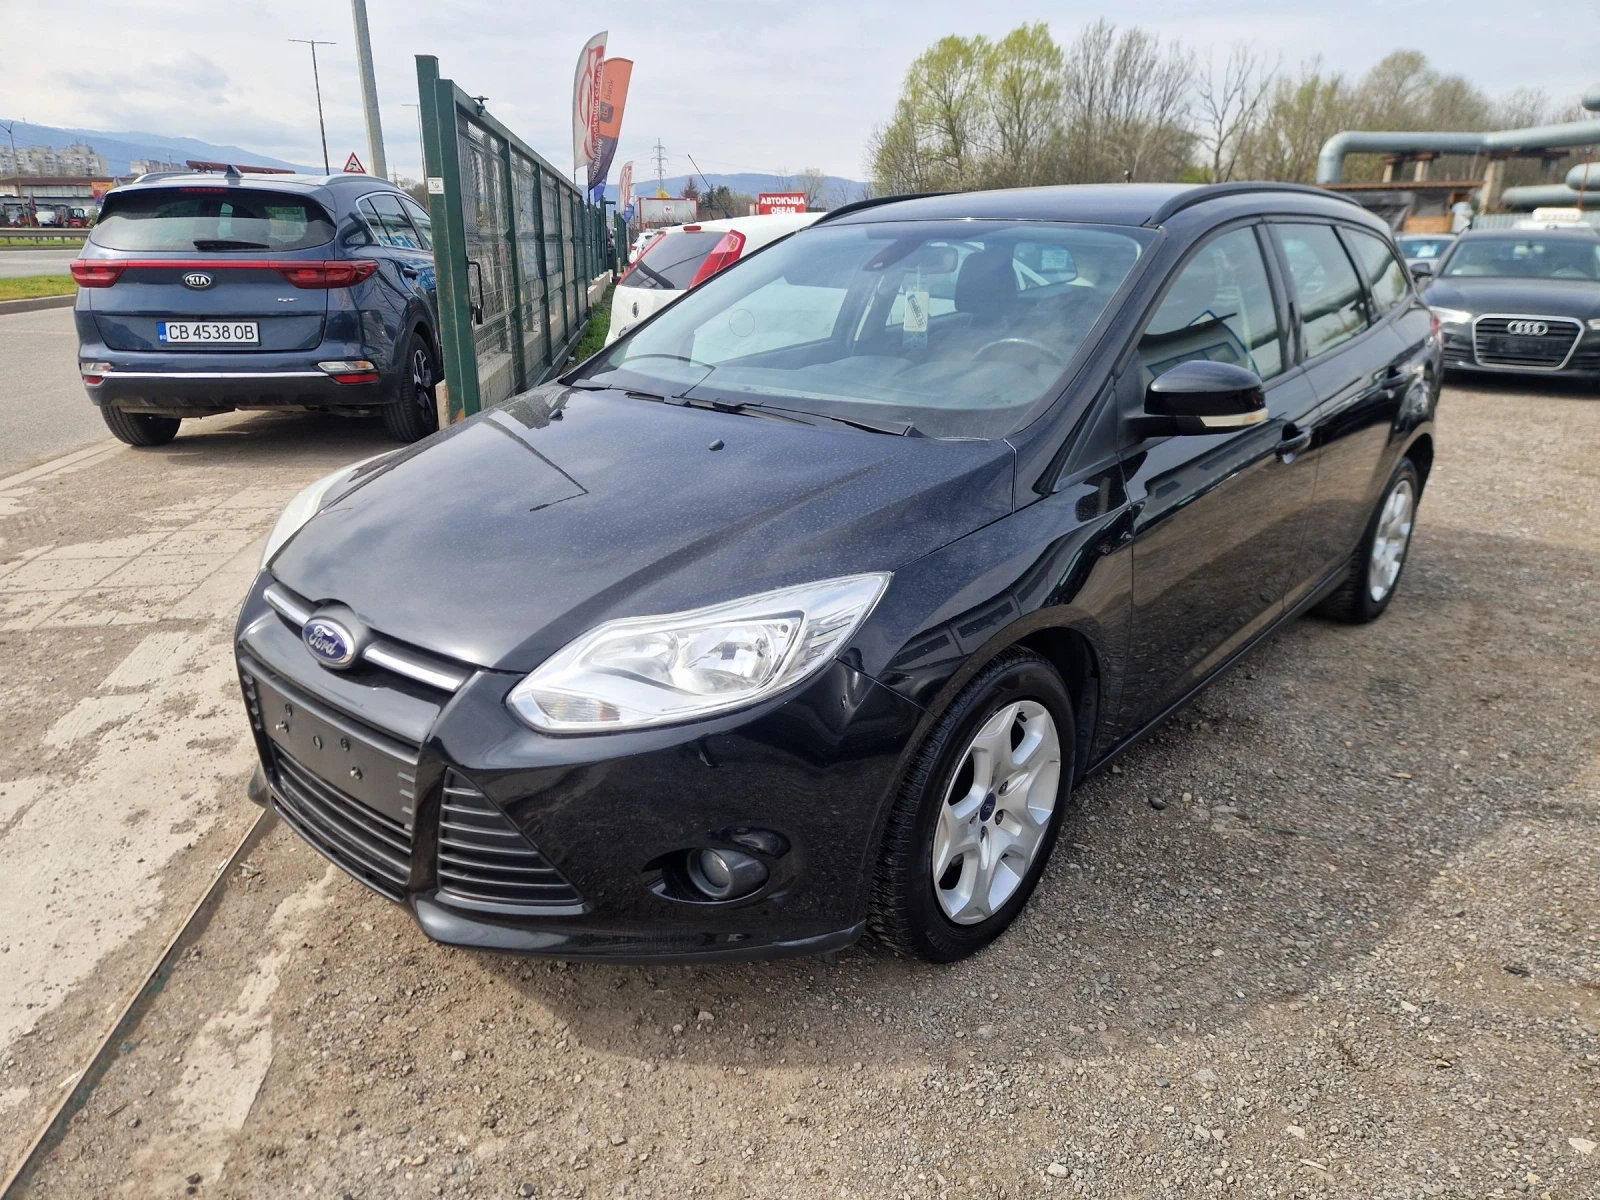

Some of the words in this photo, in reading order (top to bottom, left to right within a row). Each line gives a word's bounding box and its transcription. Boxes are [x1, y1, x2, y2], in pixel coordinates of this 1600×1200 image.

[604, 79, 614, 101] bank
[601, 105, 609, 118] tbi
[760, 196, 805, 206] АВТОКЪЩА
[770, 206, 796, 215] ОБЕЛЯ
[188, 276, 208, 285] KIA
[168, 325, 190, 340] CB
[193, 325, 231, 340] 4538
[308, 624, 340, 656] Ford
